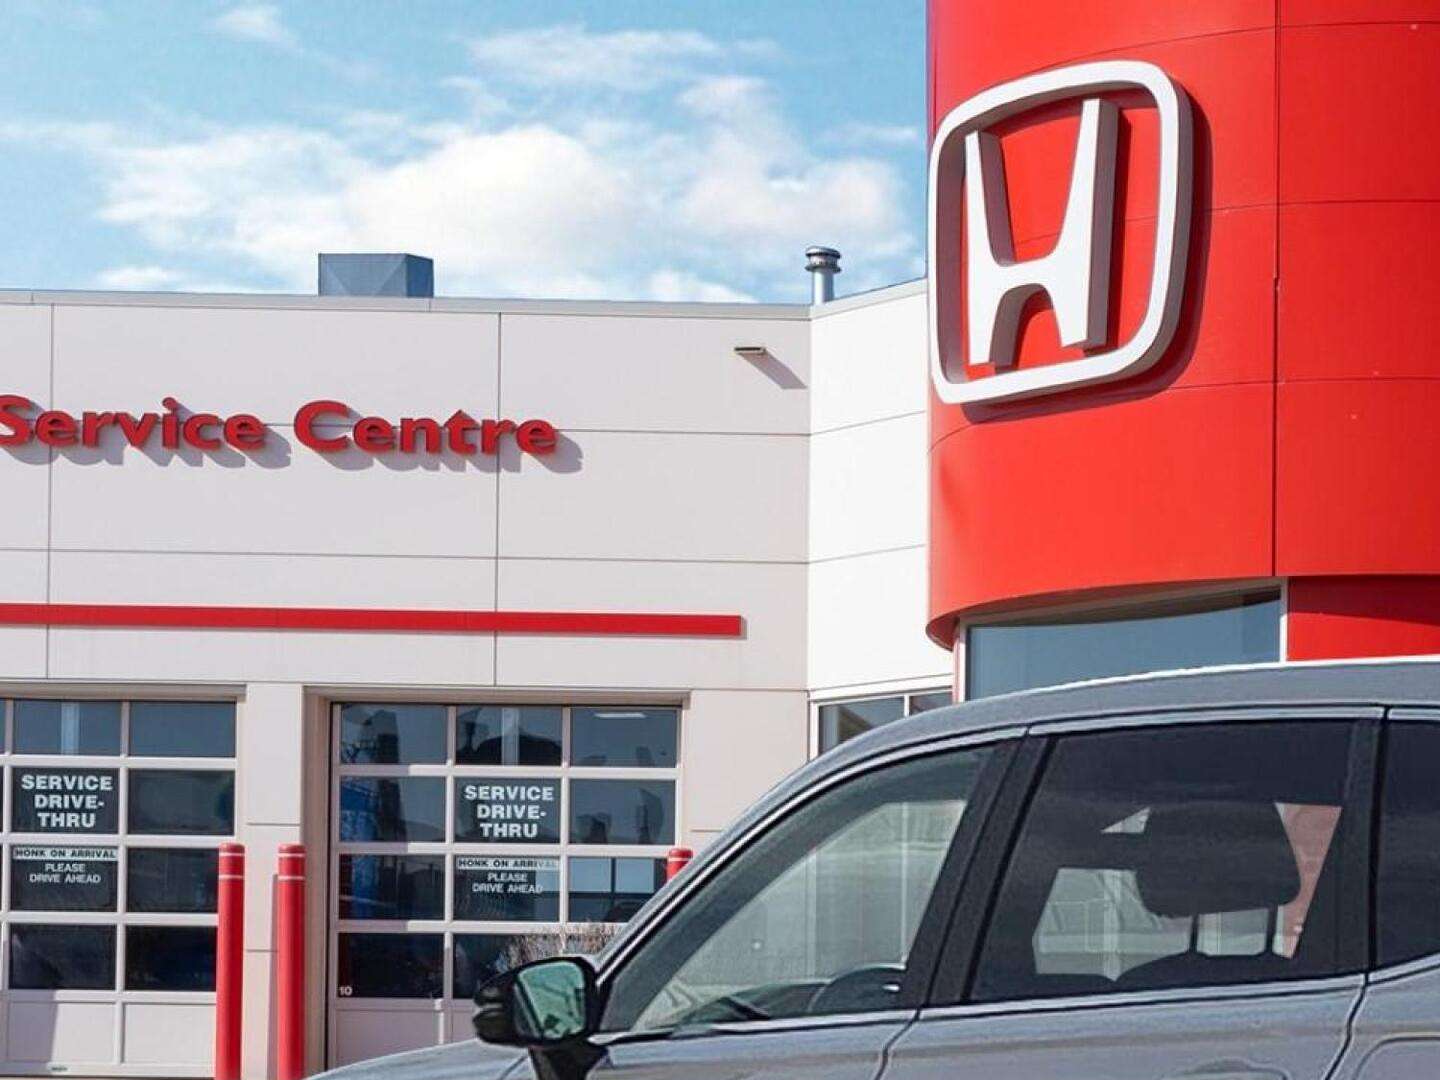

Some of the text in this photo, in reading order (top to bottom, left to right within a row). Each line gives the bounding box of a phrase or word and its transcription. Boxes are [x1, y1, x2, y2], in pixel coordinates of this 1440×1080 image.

[0, 394, 557, 456] Service Centre
[21, 774, 113, 790] SERVICE
[464, 785, 555, 801] SERVICE
[34, 794, 105, 809] DRIVE-
[477, 804, 547, 820] DRIVE-
[37, 812, 96, 828] THRU
[480, 823, 538, 838] THRU
[16, 850, 116, 858] HONK ON ARRIVAL
[45, 863, 86, 873] PLEASE
[459, 859, 488, 868] HONK
[493, 859, 509, 868] ON
[29, 873, 101, 884] DRIVE AHEAD
[487, 872, 528, 882] PLEASE
[472, 883, 544, 894] DRIVE AHEAD
[340, 986, 353, 996] 10
